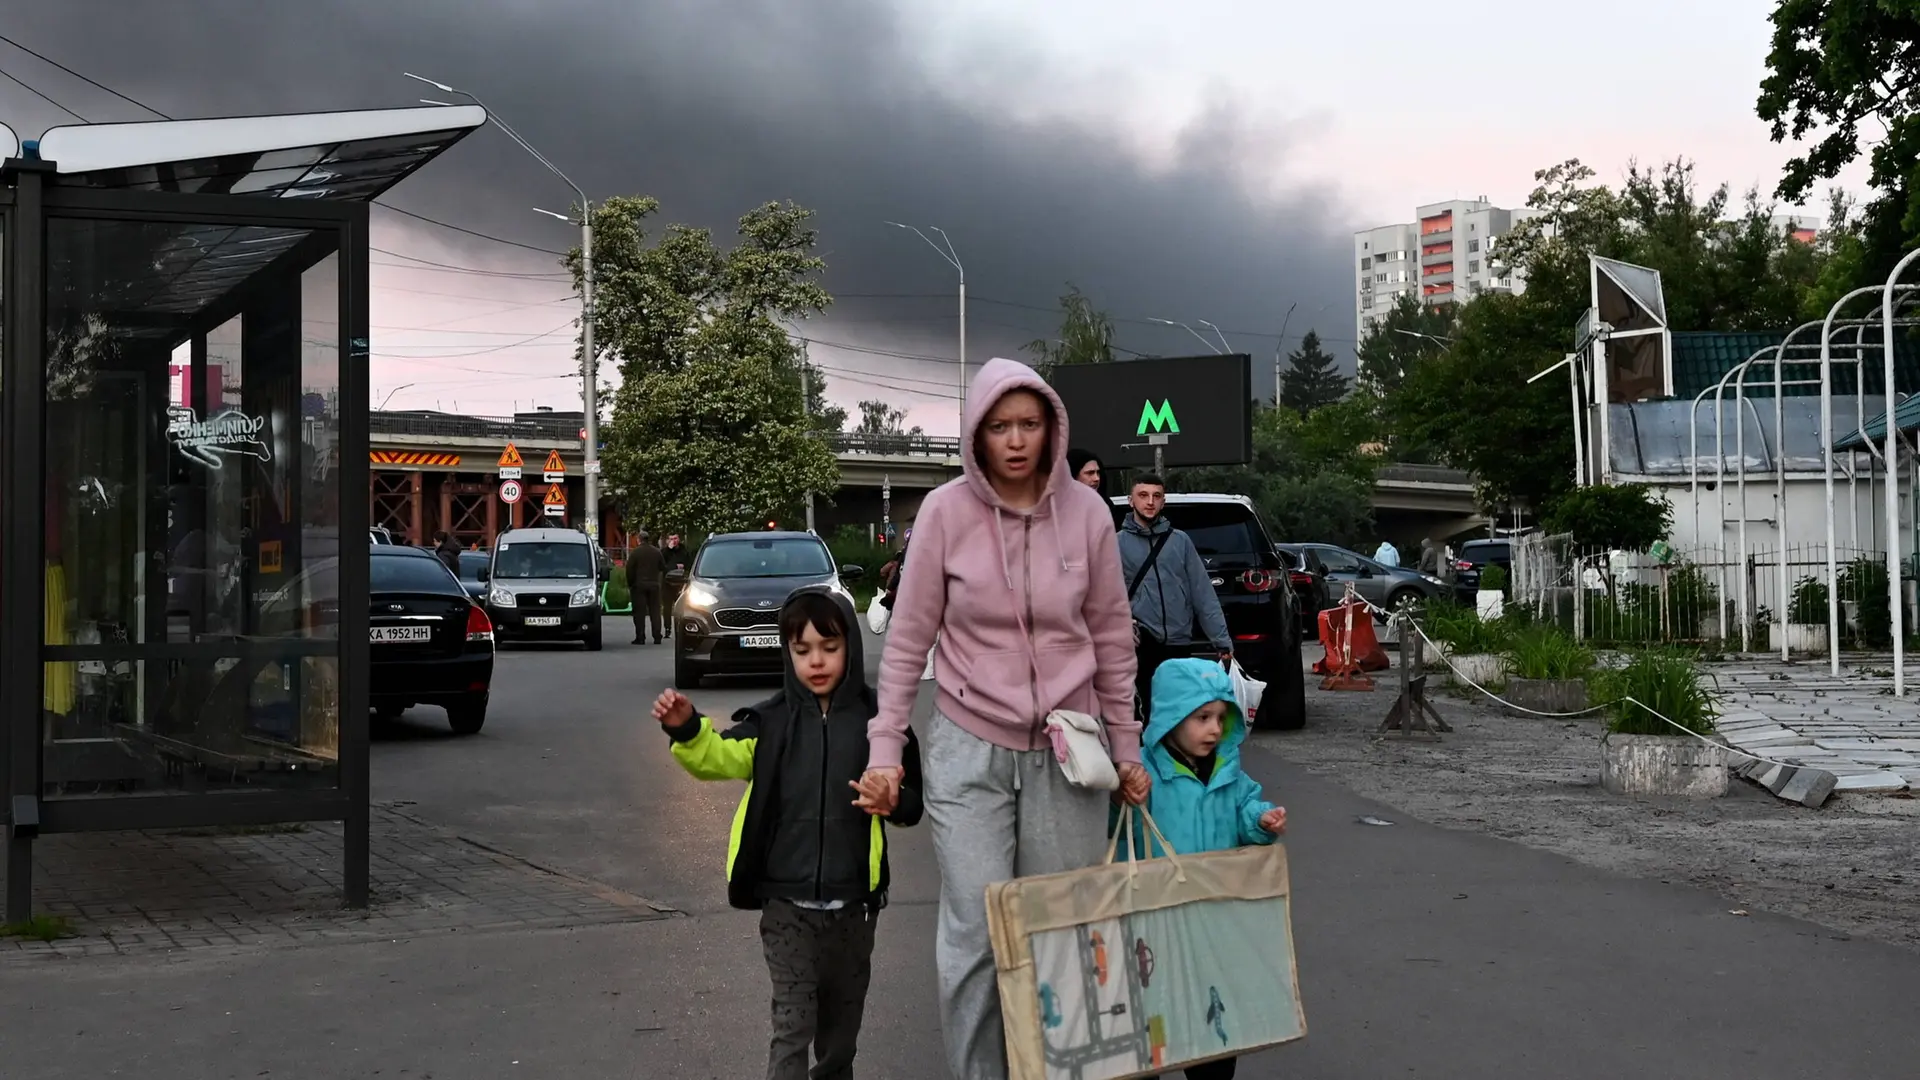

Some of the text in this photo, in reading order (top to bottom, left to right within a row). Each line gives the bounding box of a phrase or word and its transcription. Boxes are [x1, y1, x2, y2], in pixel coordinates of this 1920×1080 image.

[504, 487, 517, 496] 40
[387, 628, 410, 640] 1952
[412, 627, 428, 639] HH
[745, 637, 757, 645] AA
[758, 637, 777, 645] 2005
